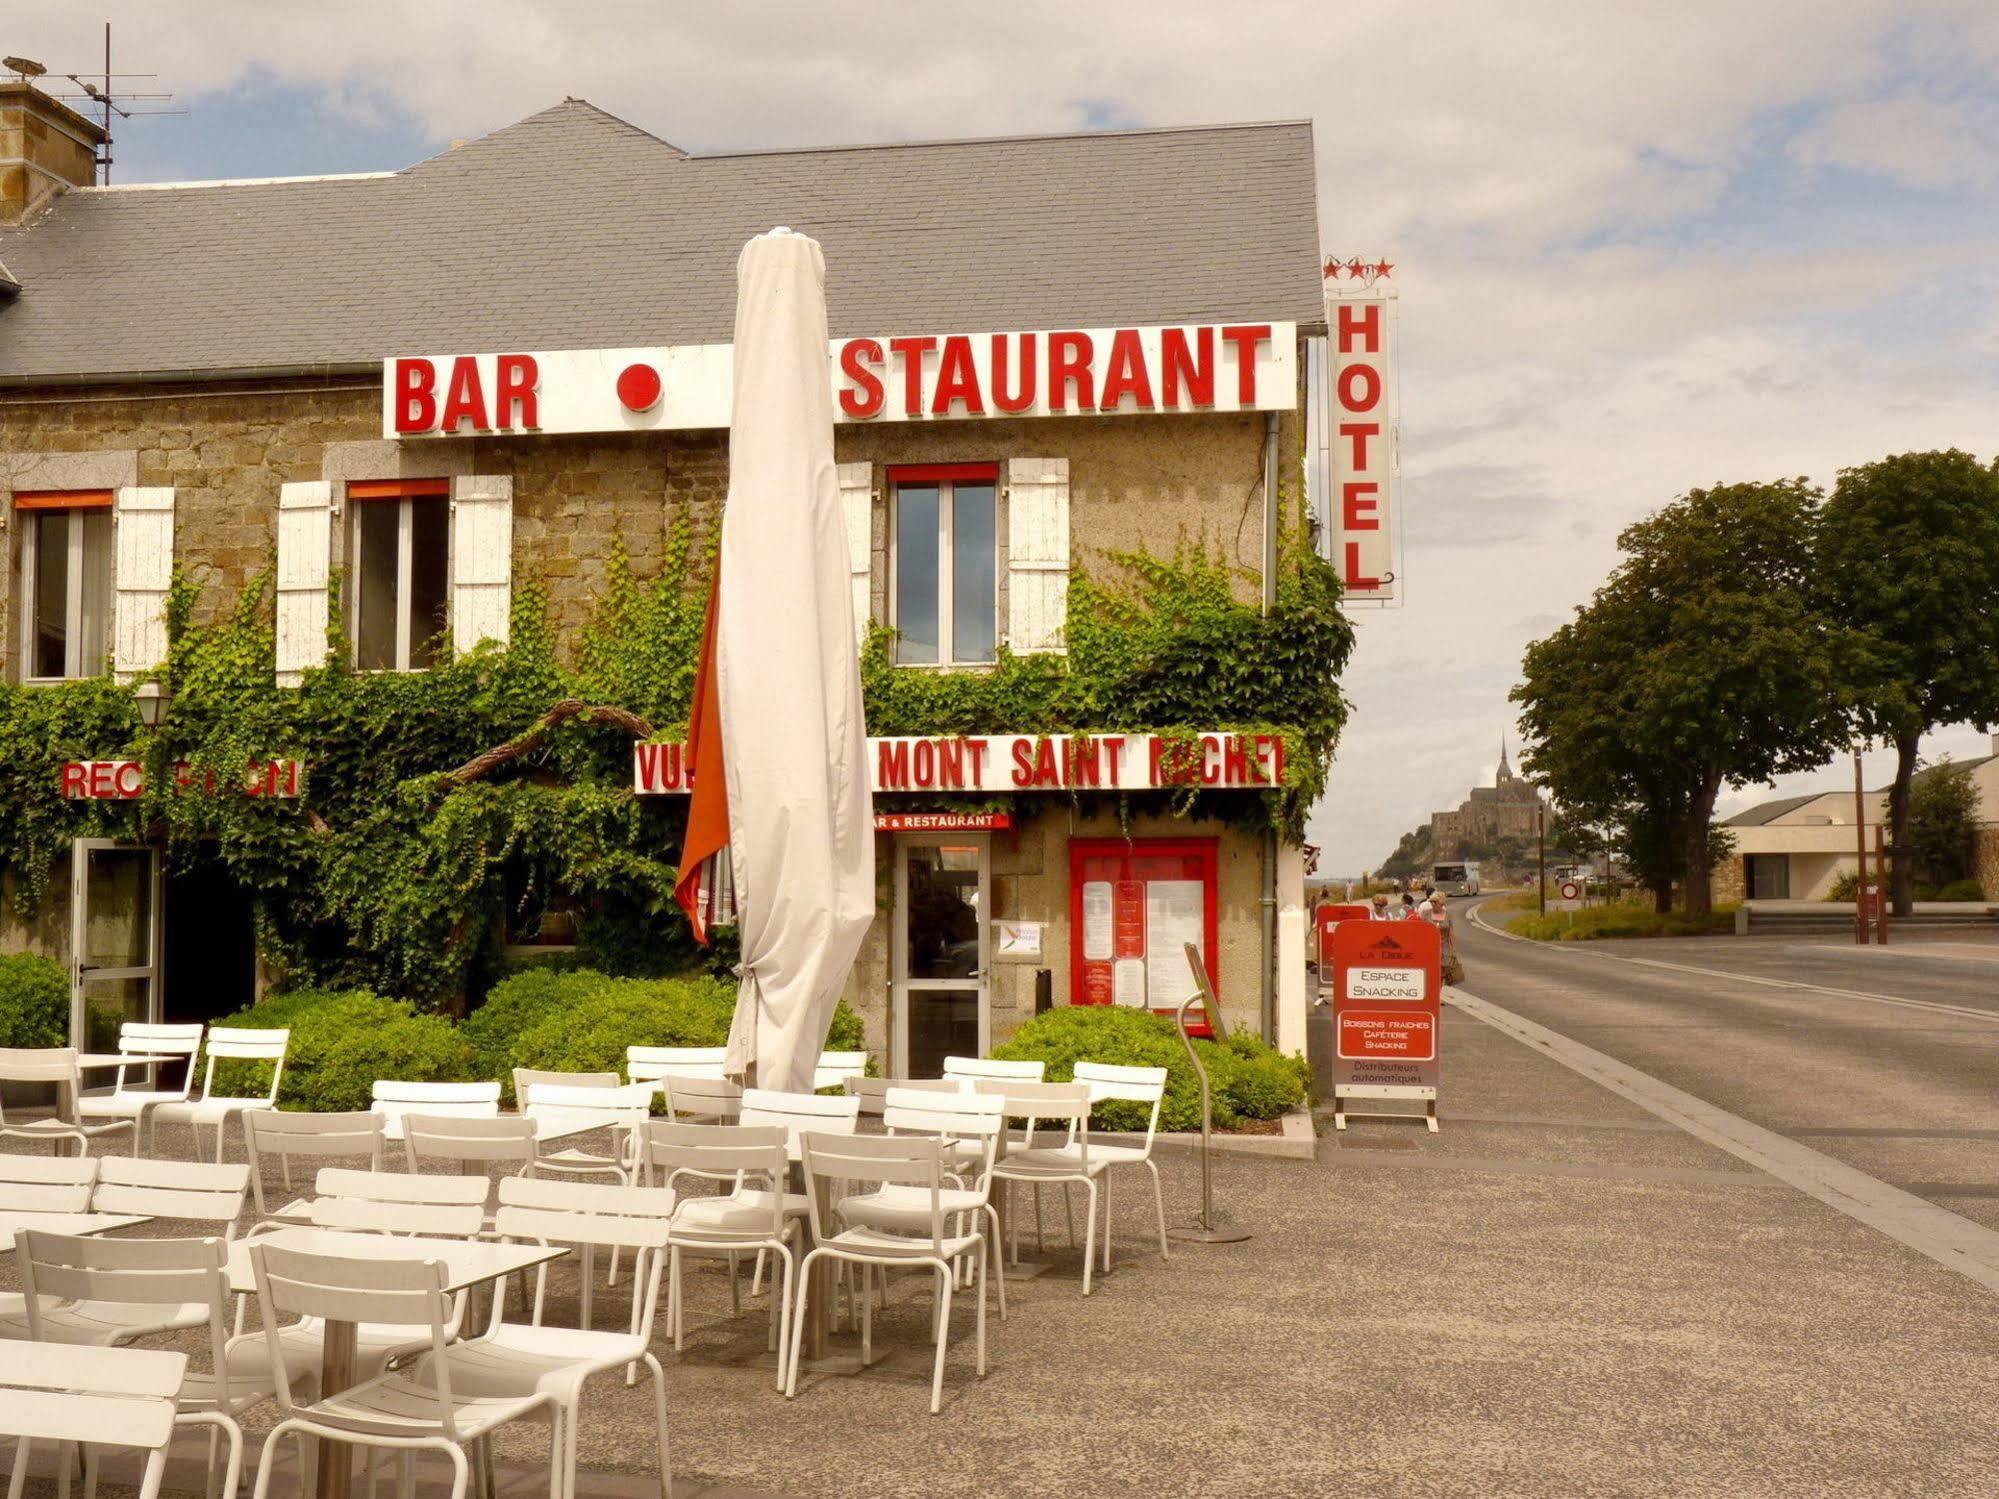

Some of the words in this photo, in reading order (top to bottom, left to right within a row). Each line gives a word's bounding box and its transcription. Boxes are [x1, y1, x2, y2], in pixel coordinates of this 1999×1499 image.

[395, 354, 539, 432] BAR
[839, 325, 1271, 419] STAURANT
[1337, 305, 1381, 591] HOTEL
[878, 740, 988, 788] MONT
[1011, 738, 1125, 787] SAINT
[871, 817, 887, 828] AR
[891, 818, 900, 828] &
[904, 815, 993, 828] RESTAURANT
[1361, 970, 1411, 982] ESPACE
[1353, 986, 1419, 998] SNACKING
[1343, 1020, 1385, 1029] BOISSONS
[1365, 1040, 1408, 1050] SNACKING
[1354, 1061, 1420, 1073] Distributeurs
[1351, 1073, 1422, 1086] automatiques
